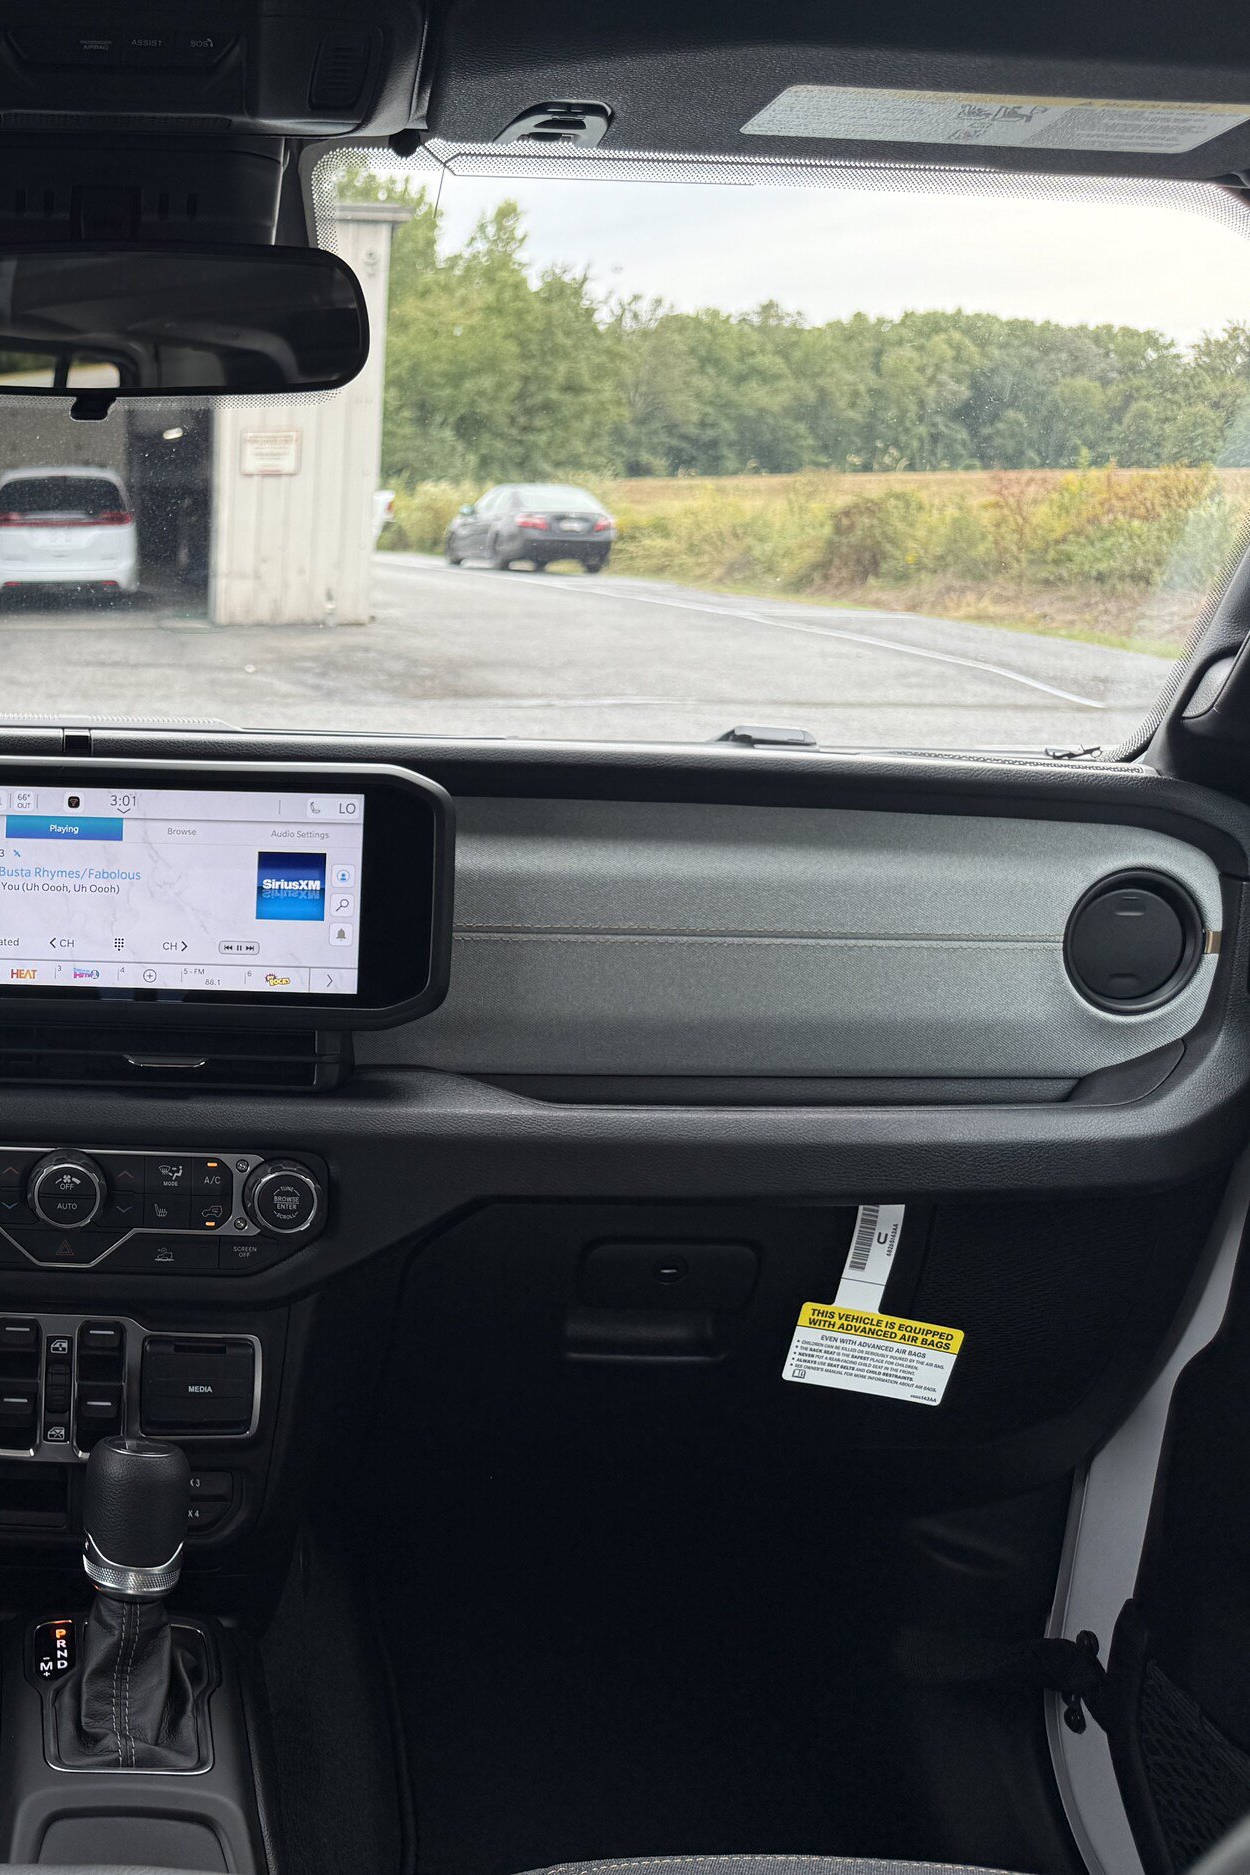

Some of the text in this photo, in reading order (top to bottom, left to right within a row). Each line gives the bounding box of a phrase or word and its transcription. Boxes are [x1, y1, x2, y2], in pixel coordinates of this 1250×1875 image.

[131, 39, 162, 47] ASSIST
[190, 40, 209, 48] SOS
[110, 795, 137, 806] 3:01
[339, 803, 356, 815] LO
[49, 824, 79, 834] Playing
[167, 827, 197, 837] Browse
[271, 830, 330, 840] Audio Settings
[0, 848, 5, 858] 3
[35, 867, 141, 882] Rhymes/Fabolous
[1, 881, 20, 891] You
[22, 881, 39, 893] (Uh
[41, 882, 71, 893] Oooh,
[73, 883, 87, 893] Uh
[89, 883, 120, 895] Oooh)
[262, 879, 321, 891] SiriusXM
[59, 939, 75, 948] CH
[163, 941, 178, 951] CH
[10, 968, 38, 981] HEAT
[205, 979, 221, 987] 88.1
[204, 1176, 221, 1185] A/C
[273, 1195, 300, 1203] BROWSE
[276, 1203, 298, 1211] ENTER
[810, 1308, 954, 1341] THIS VEHICLE IS EQUIPPED
[807, 1317, 951, 1350] WITH ADVANCED AIR BAGS
[821, 1334, 838, 1342] EVEN
[857, 1341, 894, 1352] ADVANCED
[907, 1350, 926, 1358] BAGS
[188, 1385, 213, 1393] MEDIA
[55, 1629, 67, 1639] P
[56, 1639, 67, 1649] R
[56, 1649, 68, 1659] N
[40, 1661, 53, 1671] M
[57, 1660, 68, 1669] D
